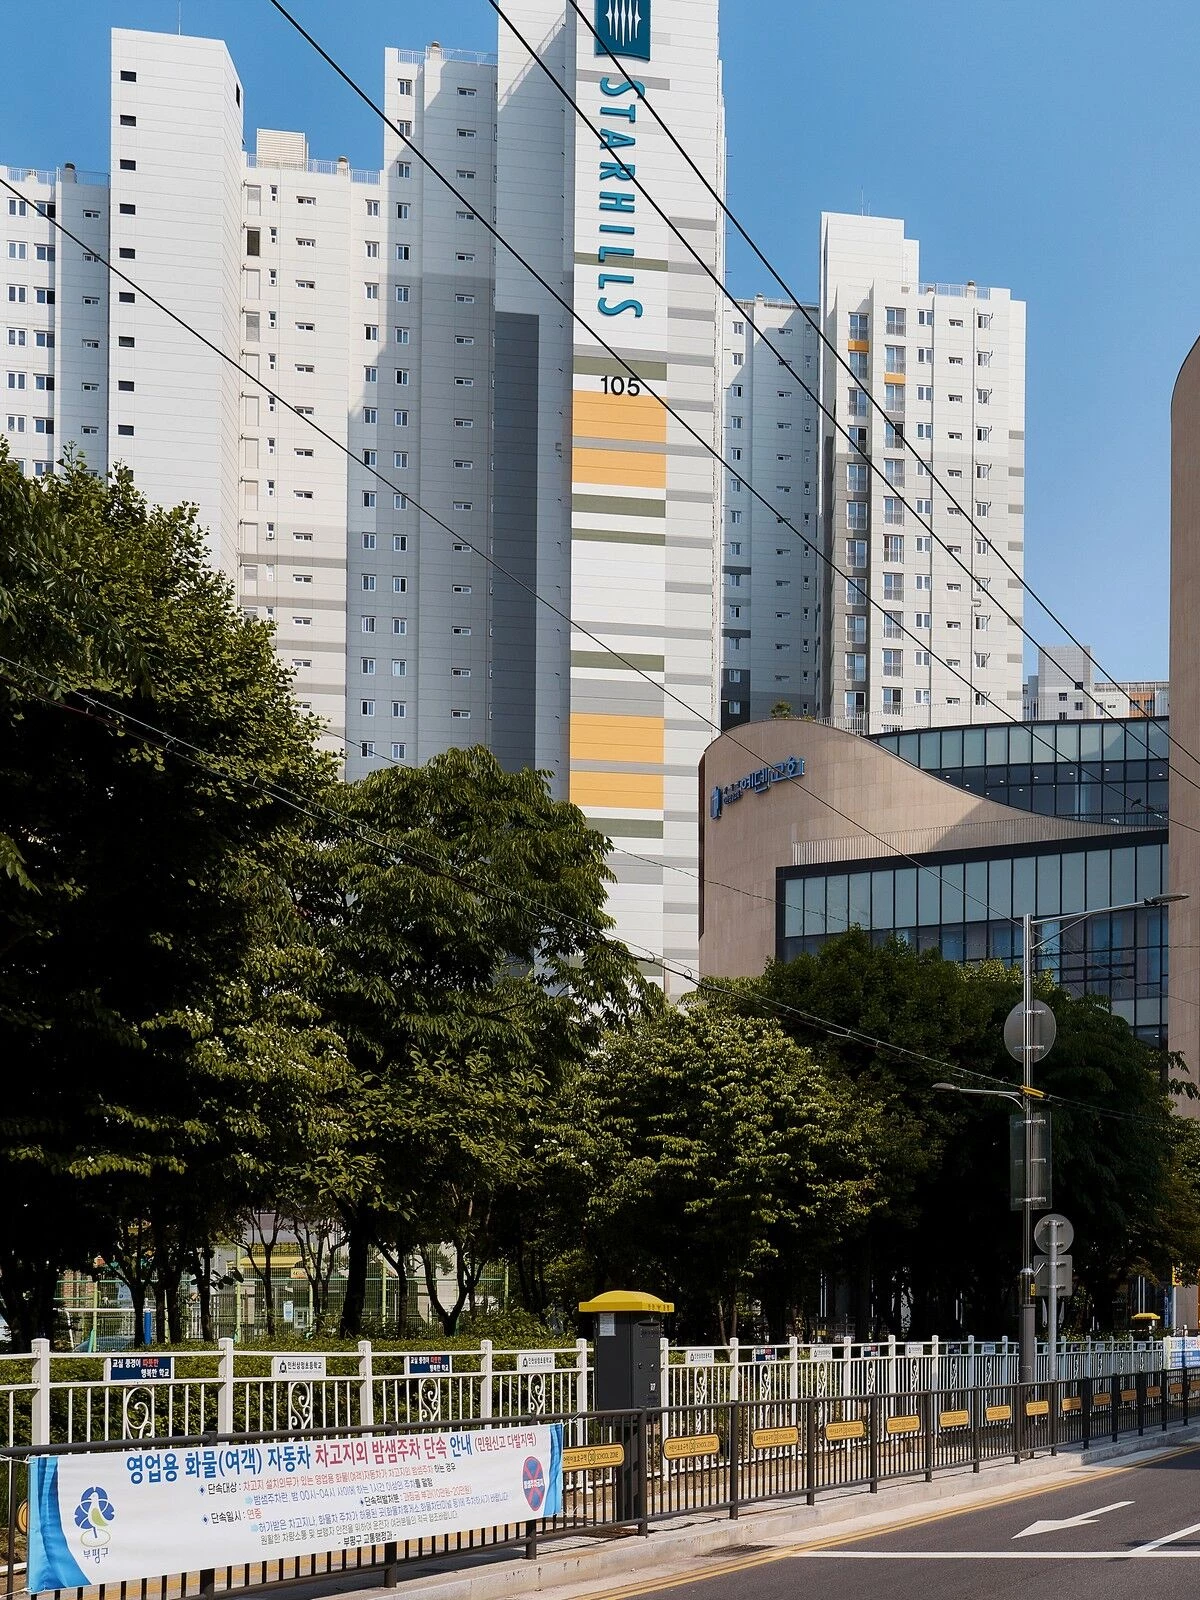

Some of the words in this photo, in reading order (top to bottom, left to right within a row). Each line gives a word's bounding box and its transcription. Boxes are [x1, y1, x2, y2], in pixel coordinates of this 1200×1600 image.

[598, 76, 646, 318] STARHILLS
[600, 375, 641, 397] 105
[112, 1358, 124, 1368] 교실
[125, 1358, 141, 1368] 풍경이
[141, 1368, 157, 1378] 행복한
[159, 1368, 170, 1377] 학교
[126, 1452, 180, 1485] 영업용
[185, 1447, 262, 1479] 화물(여객)
[267, 1445, 311, 1473] 자동차
[315, 1440, 369, 1468] 차고지외
[371, 1436, 422, 1465] 밤샘주차
[423, 1434, 447, 1460] 단속
[449, 1433, 473, 1458] 안내
[474, 1436, 506, 1453] (민원신고
[507, 1433, 537, 1451] 다발지역)
[207, 1480, 237, 1495] 단속대상
[210, 1508, 242, 1525] 단속일시
[246, 1506, 262, 1520] 연중
[343, 1533, 362, 1546] 부평구
[83, 1547, 109, 1564] 부평구
